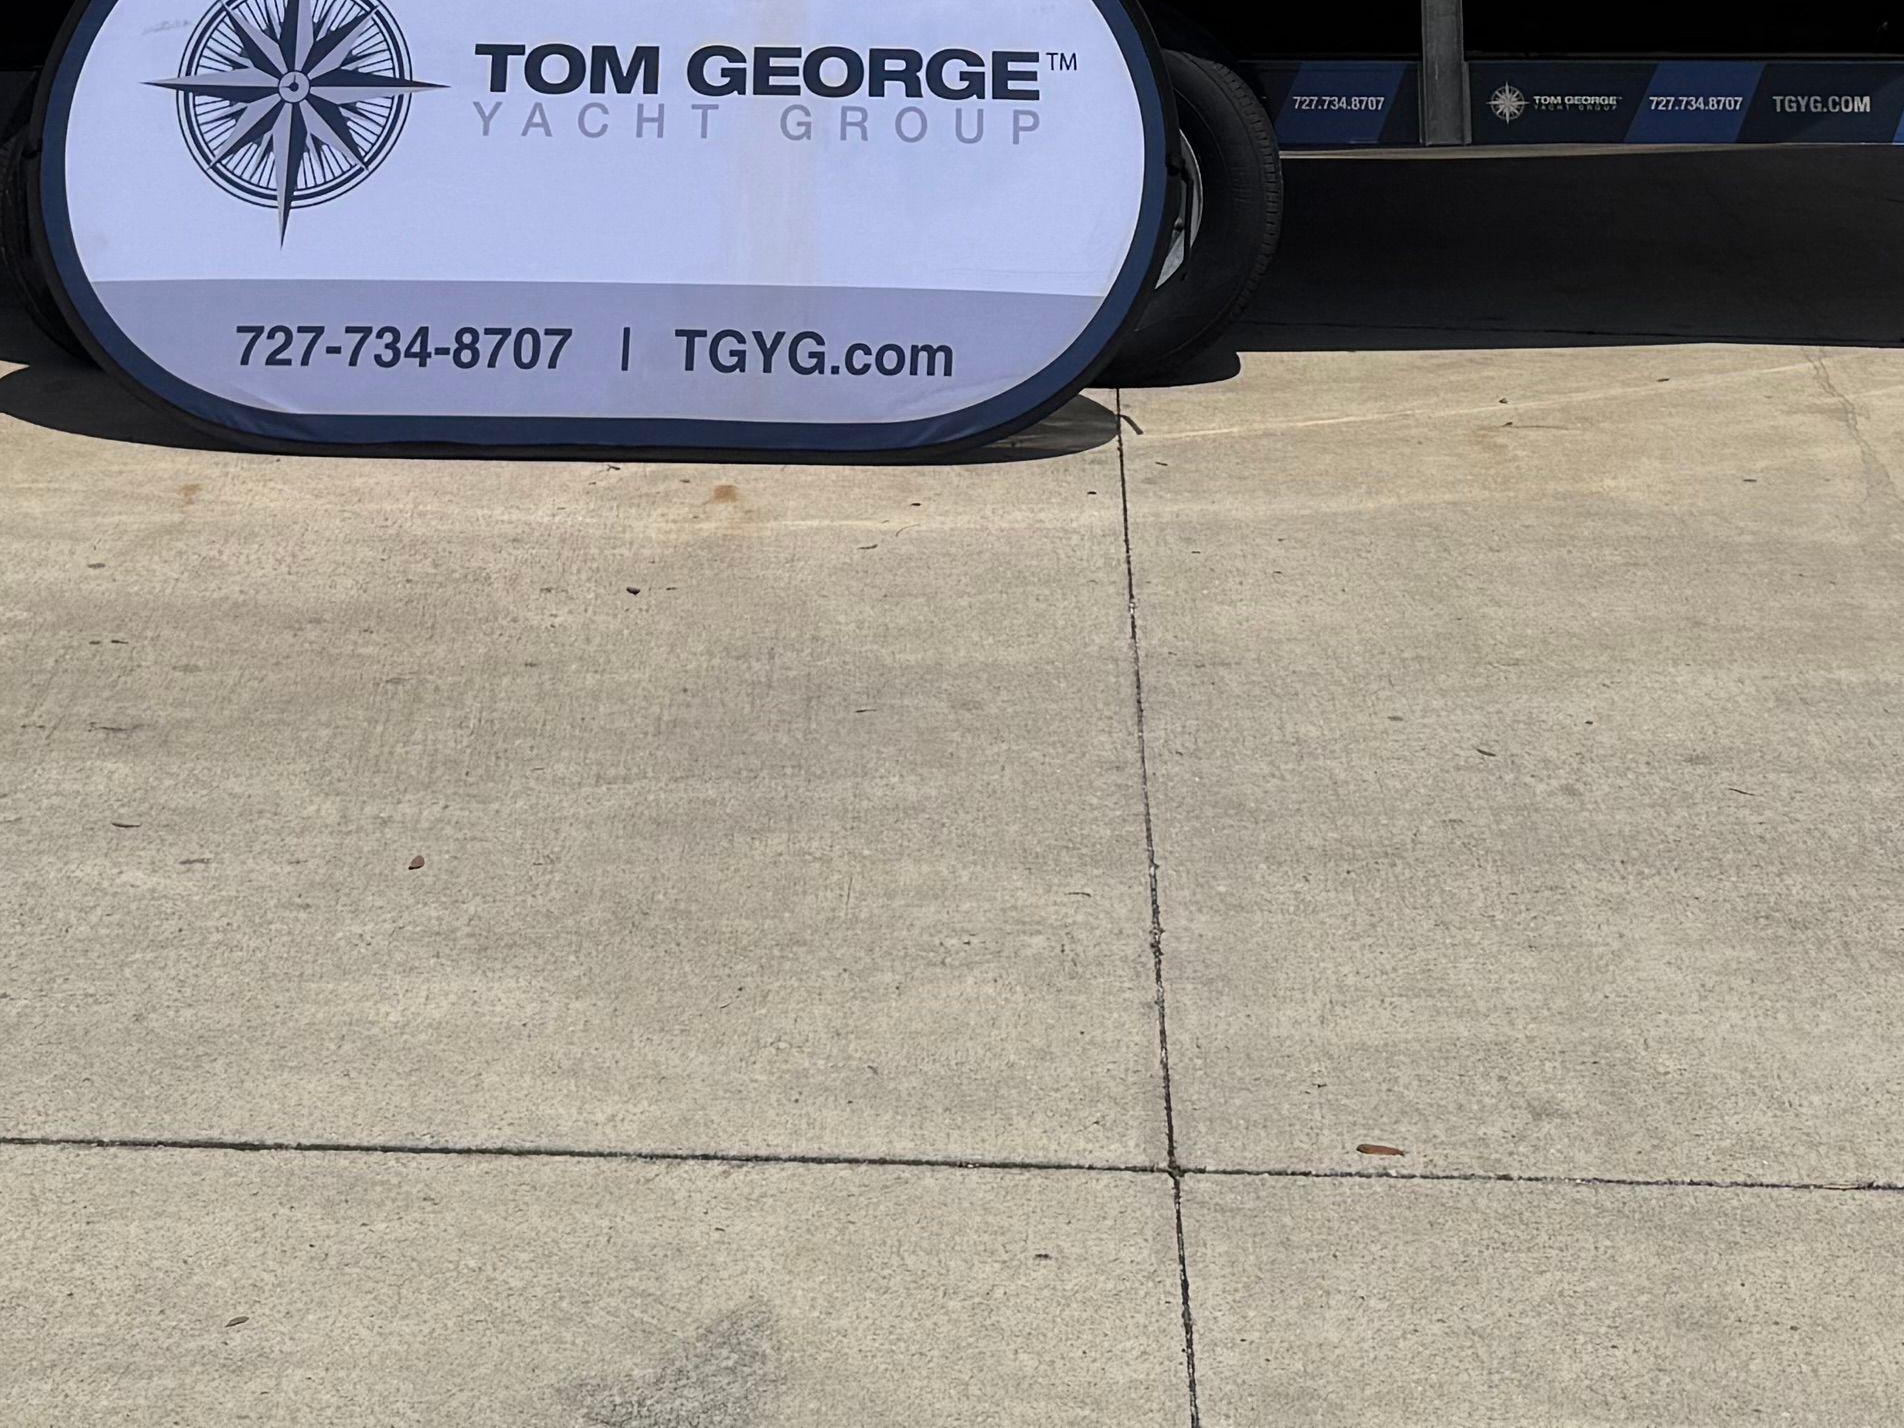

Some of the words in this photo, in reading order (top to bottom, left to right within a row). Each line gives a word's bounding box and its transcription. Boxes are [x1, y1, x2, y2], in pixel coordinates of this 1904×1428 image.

[475, 43, 661, 95] TOM
[1293, 96, 1385, 111] 727.734.8707
[1533, 96, 1562, 105] TOM
[1649, 96, 1743, 111] 727.734.8707
[1772, 95, 1871, 113] TGYG.COM
[472, 100, 720, 140] YACHT
[779, 103, 1041, 145] GROUP
[235, 324, 574, 370] 727-734-8707
[674, 327, 955, 378] TGYG.com
